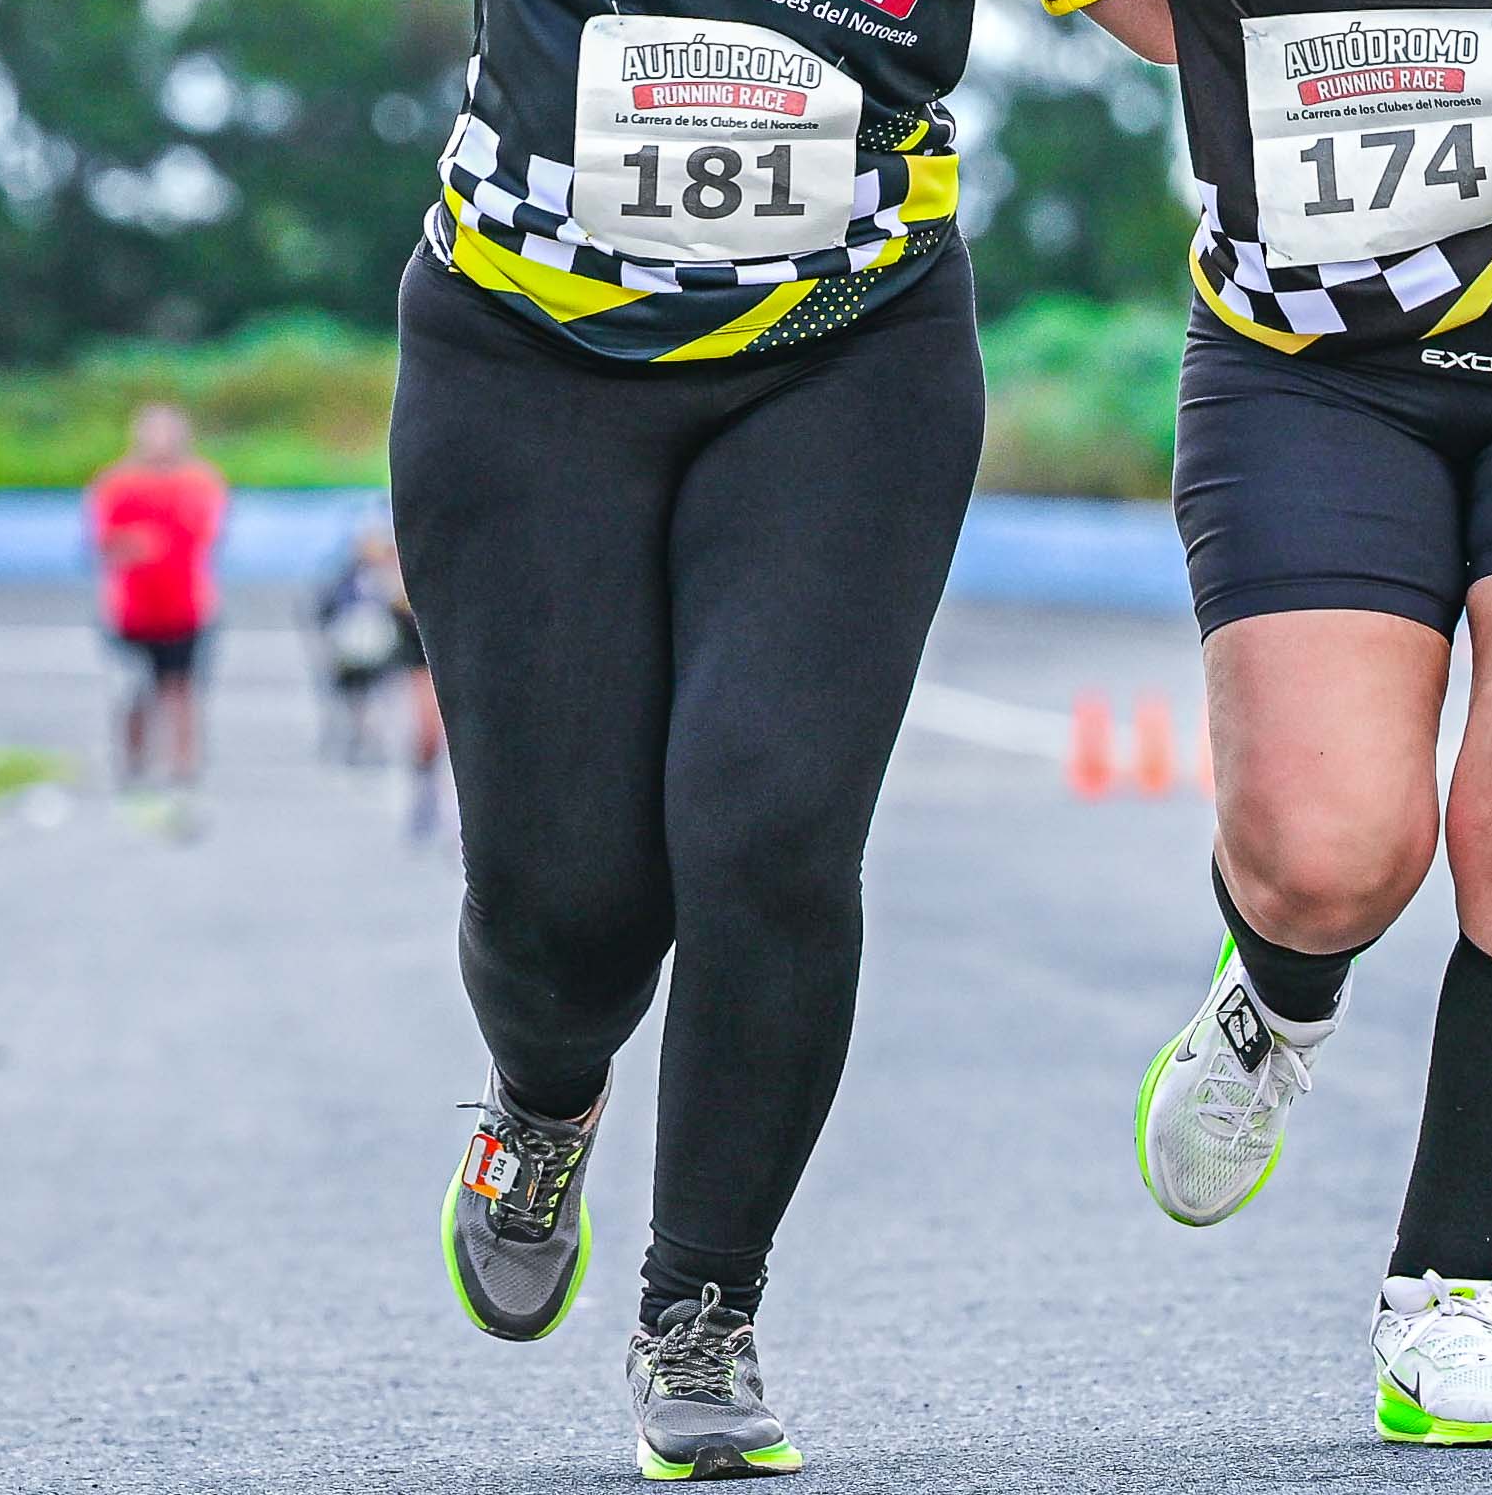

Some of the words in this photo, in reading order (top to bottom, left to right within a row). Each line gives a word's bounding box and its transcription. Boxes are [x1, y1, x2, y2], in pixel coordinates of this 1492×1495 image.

[813, 1, 849, 25] del
[847, 12, 918, 47] Noroeste
[622, 33, 822, 90] AUTÓDROMO
[1284, 22, 1478, 80] AUTÓDROMO
[651, 85, 734, 106] RUNNING
[739, 86, 788, 111] RACE
[1316, 70, 1395, 100] RUNNING
[1400, 69, 1446, 91] RACE
[615, 112, 627, 123] La
[631, 113, 672, 125] Carrera
[675, 115, 689, 126] de
[692, 115, 707, 126] los
[710, 116, 747, 128] Clubes
[751, 118, 767, 129] del
[770, 119, 819, 129] Noroeste
[1286, 110, 1299, 121] La
[1301, 109, 1341, 120] Carrera
[1343, 105, 1357, 116] de
[1359, 104, 1375, 114] los
[1377, 101, 1413, 113] Clubes
[1415, 99, 1432, 110] del
[1434, 97, 1482, 108] Noroeste
[621, 144, 805, 220] 181
[1300, 123, 1487, 217] 174
[491, 1158, 507, 1182] 134
